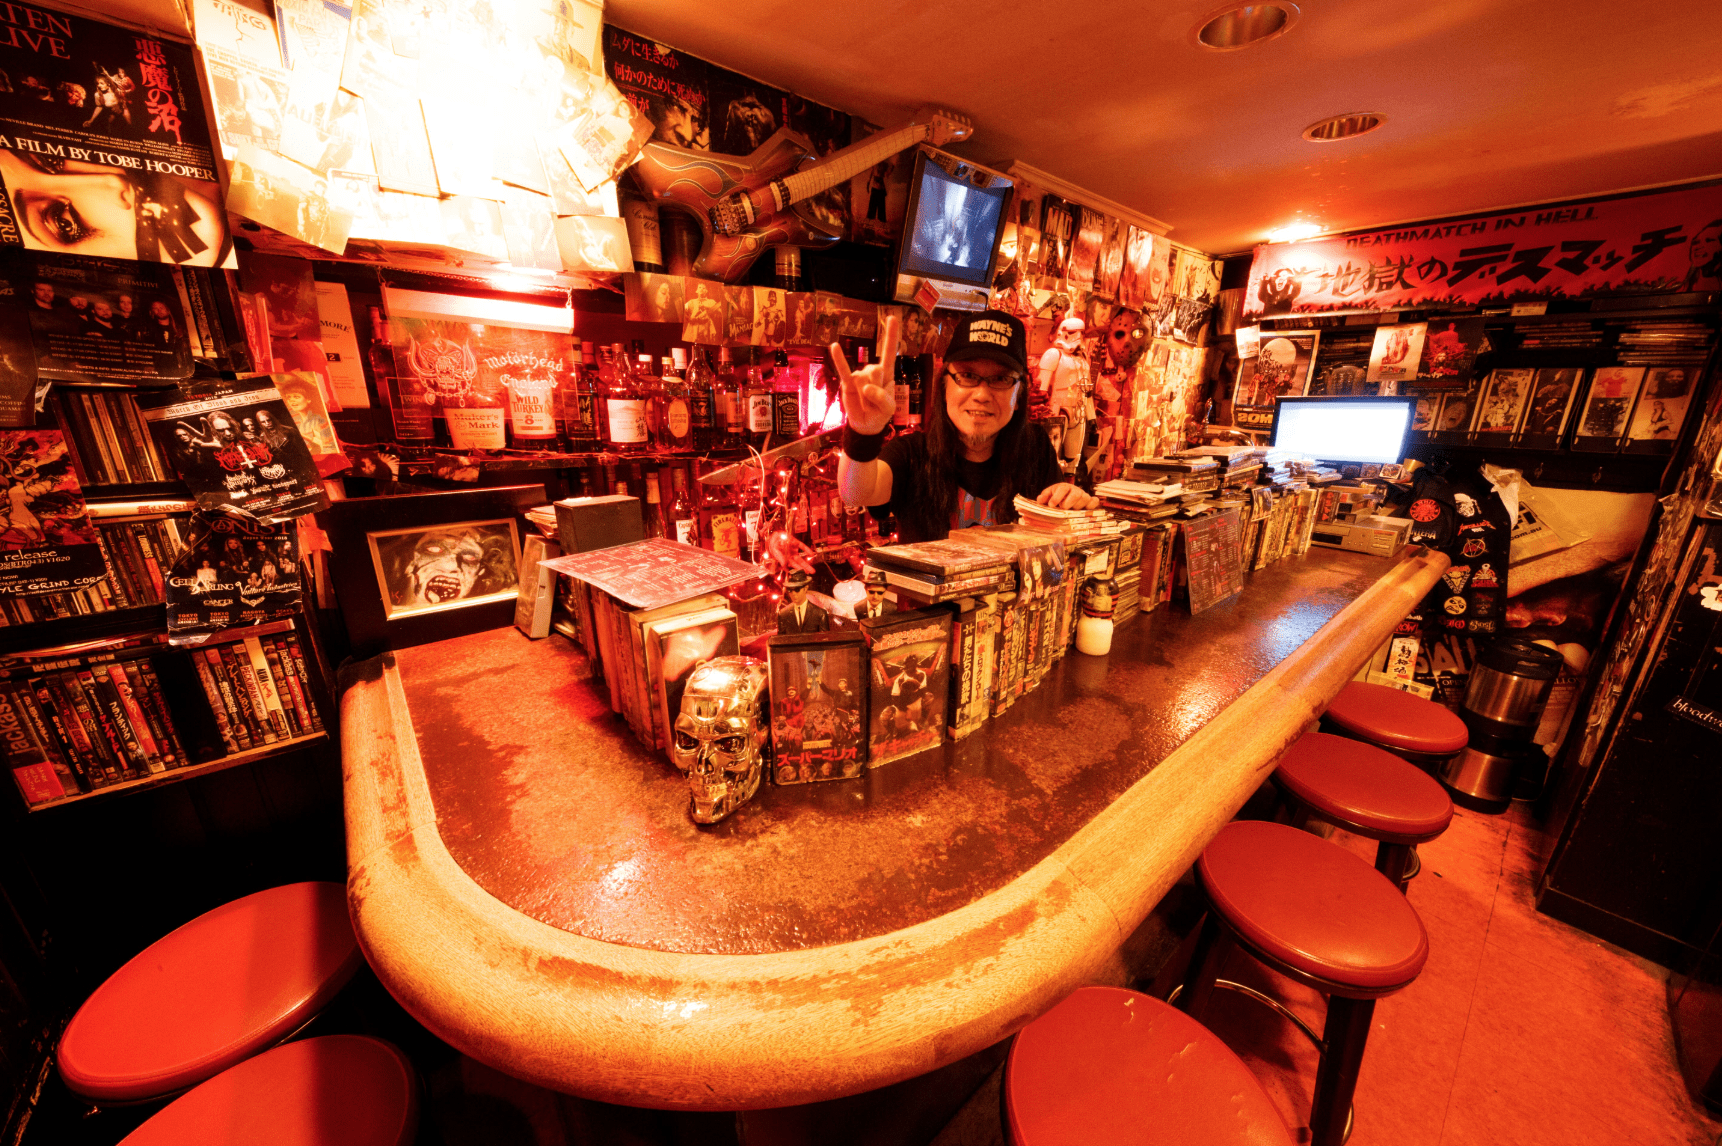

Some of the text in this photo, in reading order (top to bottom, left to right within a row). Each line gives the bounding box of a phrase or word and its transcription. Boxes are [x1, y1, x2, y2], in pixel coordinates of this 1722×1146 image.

[0, 1, 72, 39] TEN
[623, 92, 650, 114] 前が
[0, 134, 216, 181] A FILM BY TOBE HOOPER
[1345, 205, 1600, 250] DEATHMATCH IN HELL
[970, 319, 1013, 338] WAYNE'S
[969, 330, 1009, 347] WORLD
[515, 395, 539, 405] WILD
[512, 402, 544, 414] TURKEY
[468, 421, 500, 429] Mark
[524, 414, 535, 425] 8
[4, 549, 57, 561] release
[27, 581, 70, 590] GRIND
